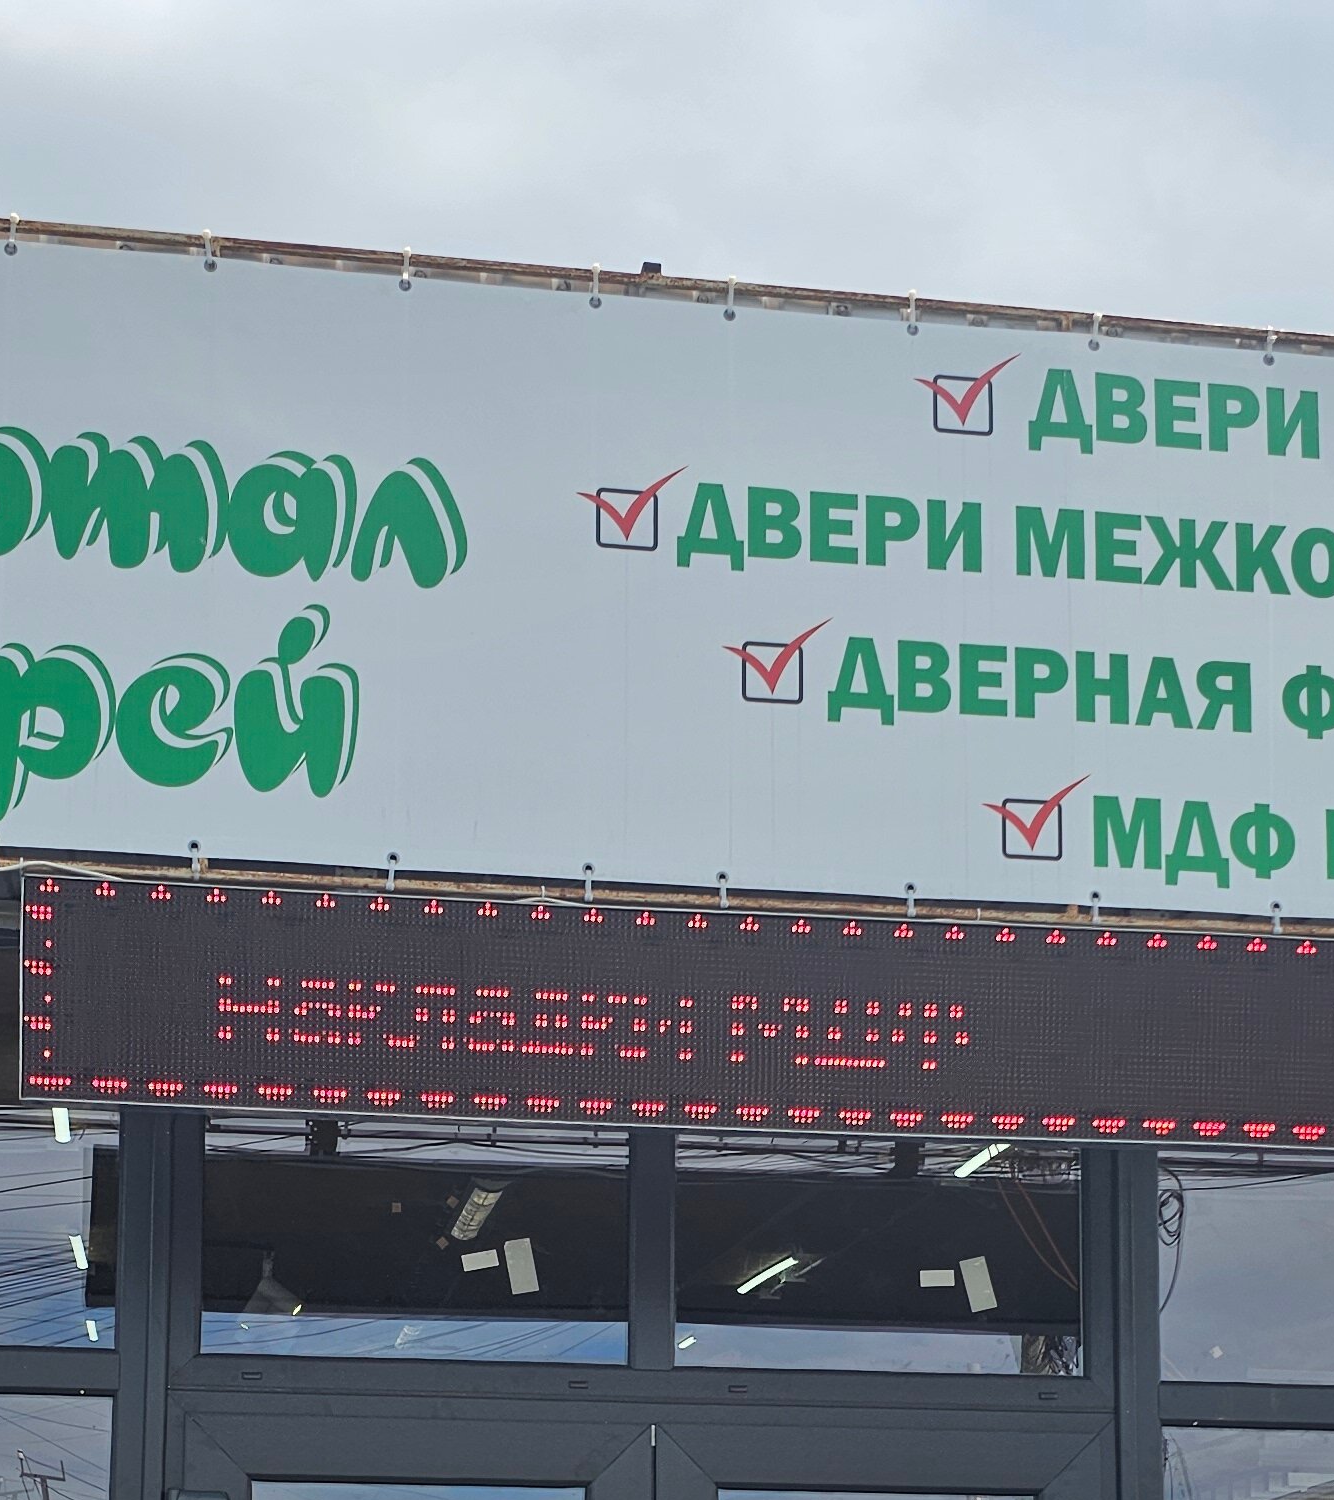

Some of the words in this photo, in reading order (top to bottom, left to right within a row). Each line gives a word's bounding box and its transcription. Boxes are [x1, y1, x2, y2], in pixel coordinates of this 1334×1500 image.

[1028, 368, 1320, 460] ДВЕРИ
[676, 482, 982, 573] ДВЕРИ
[827, 636, 1252, 733] ДВЕРНАЯ
[1093, 795, 1296, 889] МДФ
